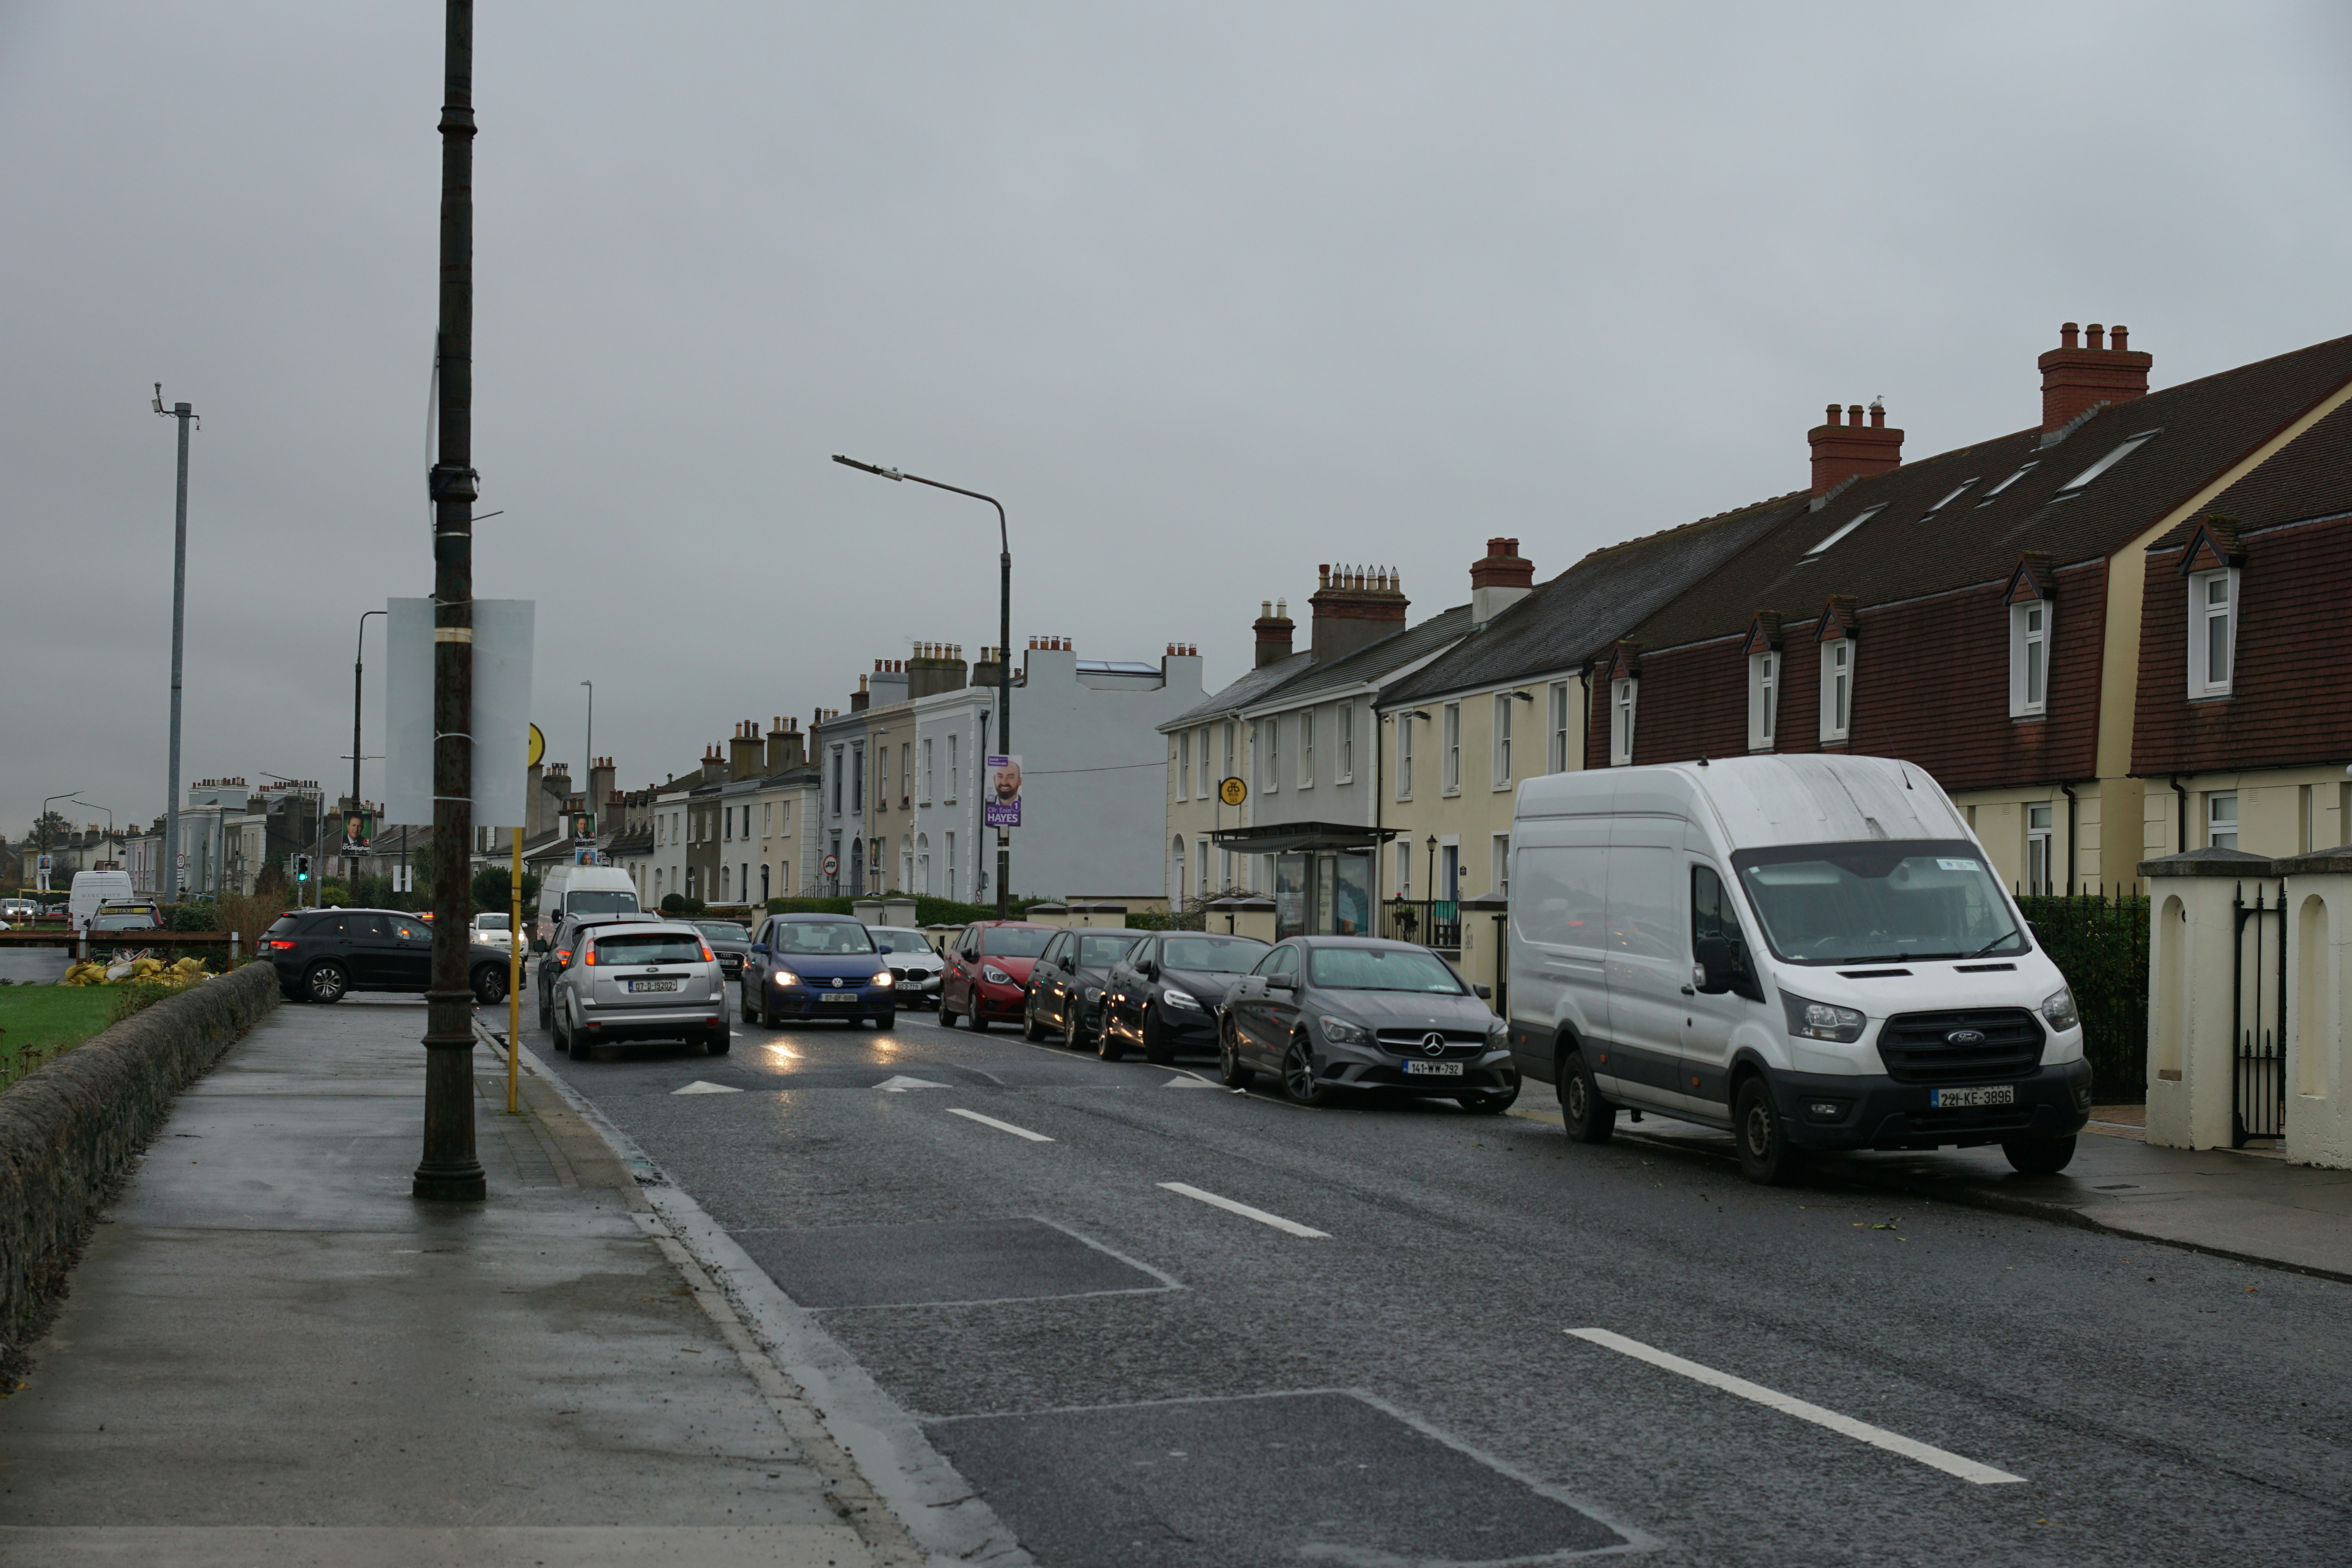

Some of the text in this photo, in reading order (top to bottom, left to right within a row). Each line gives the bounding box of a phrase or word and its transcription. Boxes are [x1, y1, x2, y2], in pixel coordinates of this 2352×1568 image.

[988, 813, 1018, 823] HAYES
[1957, 1033, 1977, 1042] Ford
[1412, 1063, 1459, 1074] 141-WW-792
[1941, 1090, 2011, 1106] 221-KE-3896
